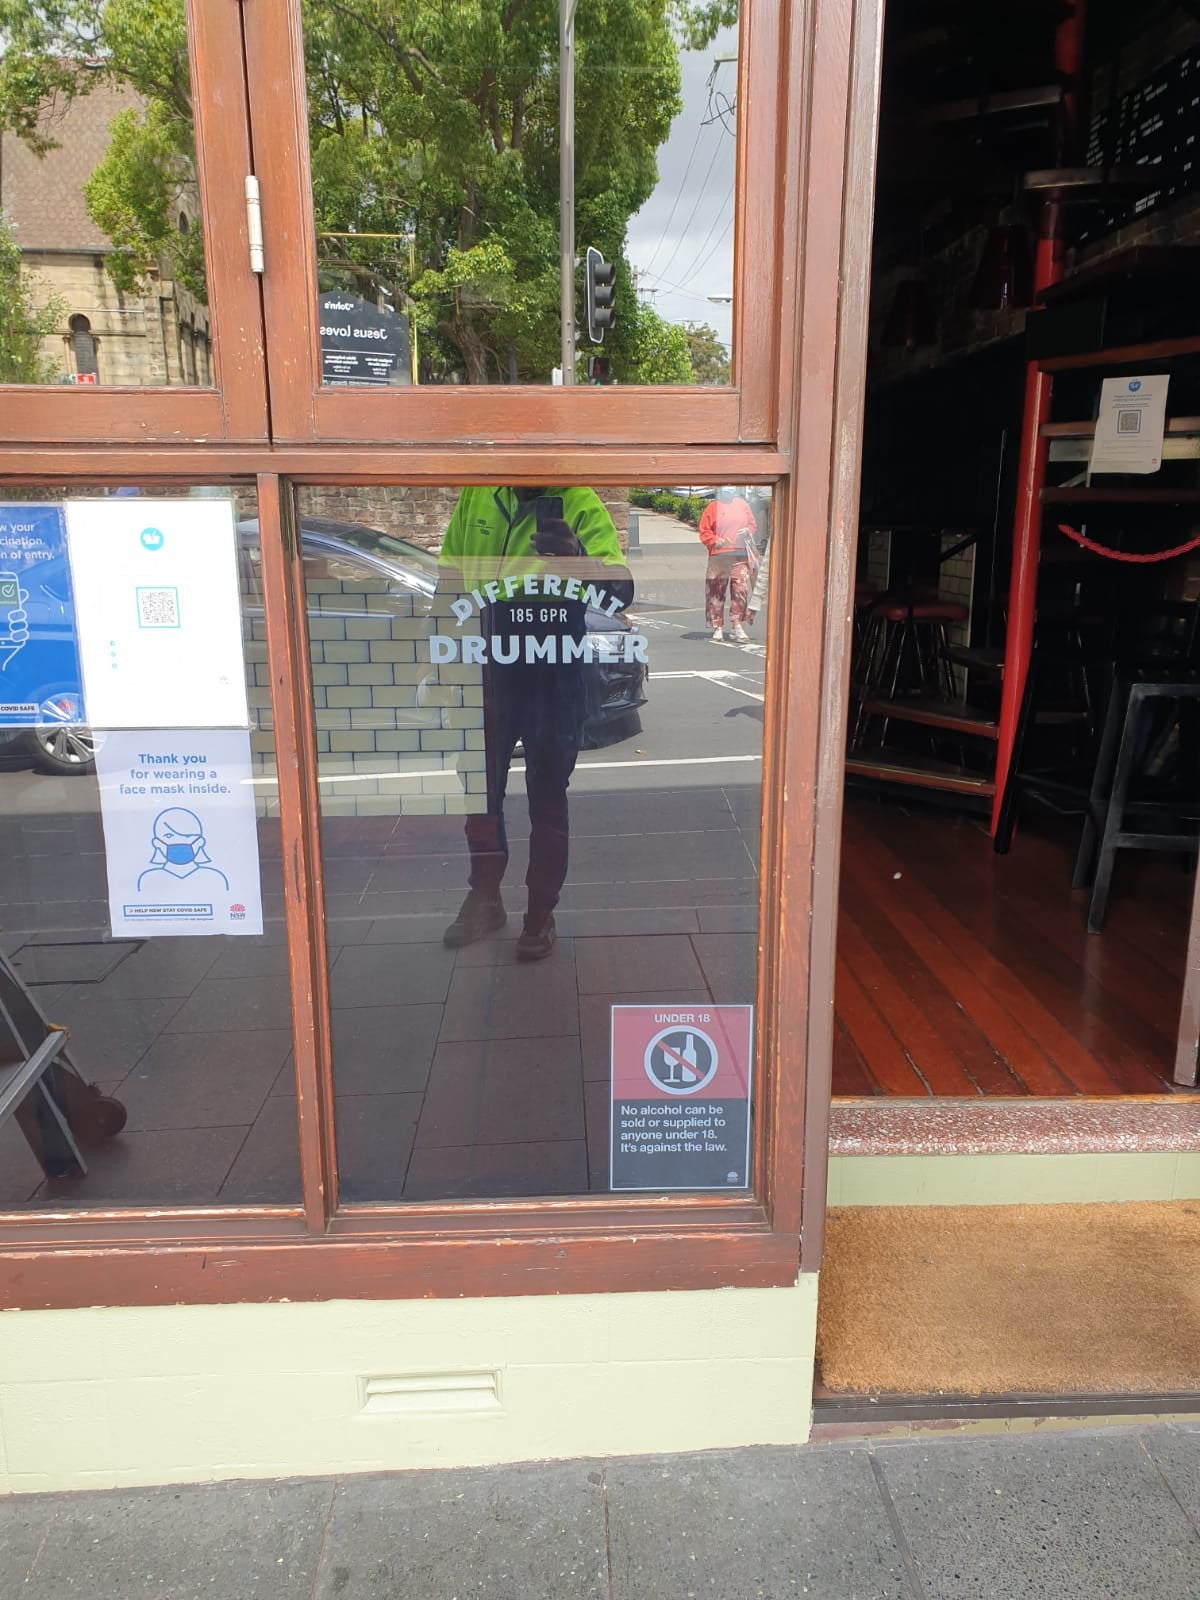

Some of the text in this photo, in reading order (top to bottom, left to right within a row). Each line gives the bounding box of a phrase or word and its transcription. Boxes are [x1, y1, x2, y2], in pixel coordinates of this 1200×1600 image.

[10, 524, 34, 534] your
[10, 550, 22, 560] of
[24, 550, 55, 561] entry.
[449, 573, 625, 627] DIFFERENT
[509, 608, 568, 623] 185 GPR
[429, 634, 649, 665] DRUMMER
[138, 753, 206, 765] Thank you
[130, 769, 217, 781] for wearing a
[119, 783, 231, 794] face mask inside.
[654, 1014, 710, 1023] UNDER 18
[621, 1105, 724, 1115] No alcohol can be
[621, 1117, 726, 1130] sold or supplied to
[621, 1130, 718, 1142] anyone under 18.
[621, 1142, 727, 1154] It's against the law.
